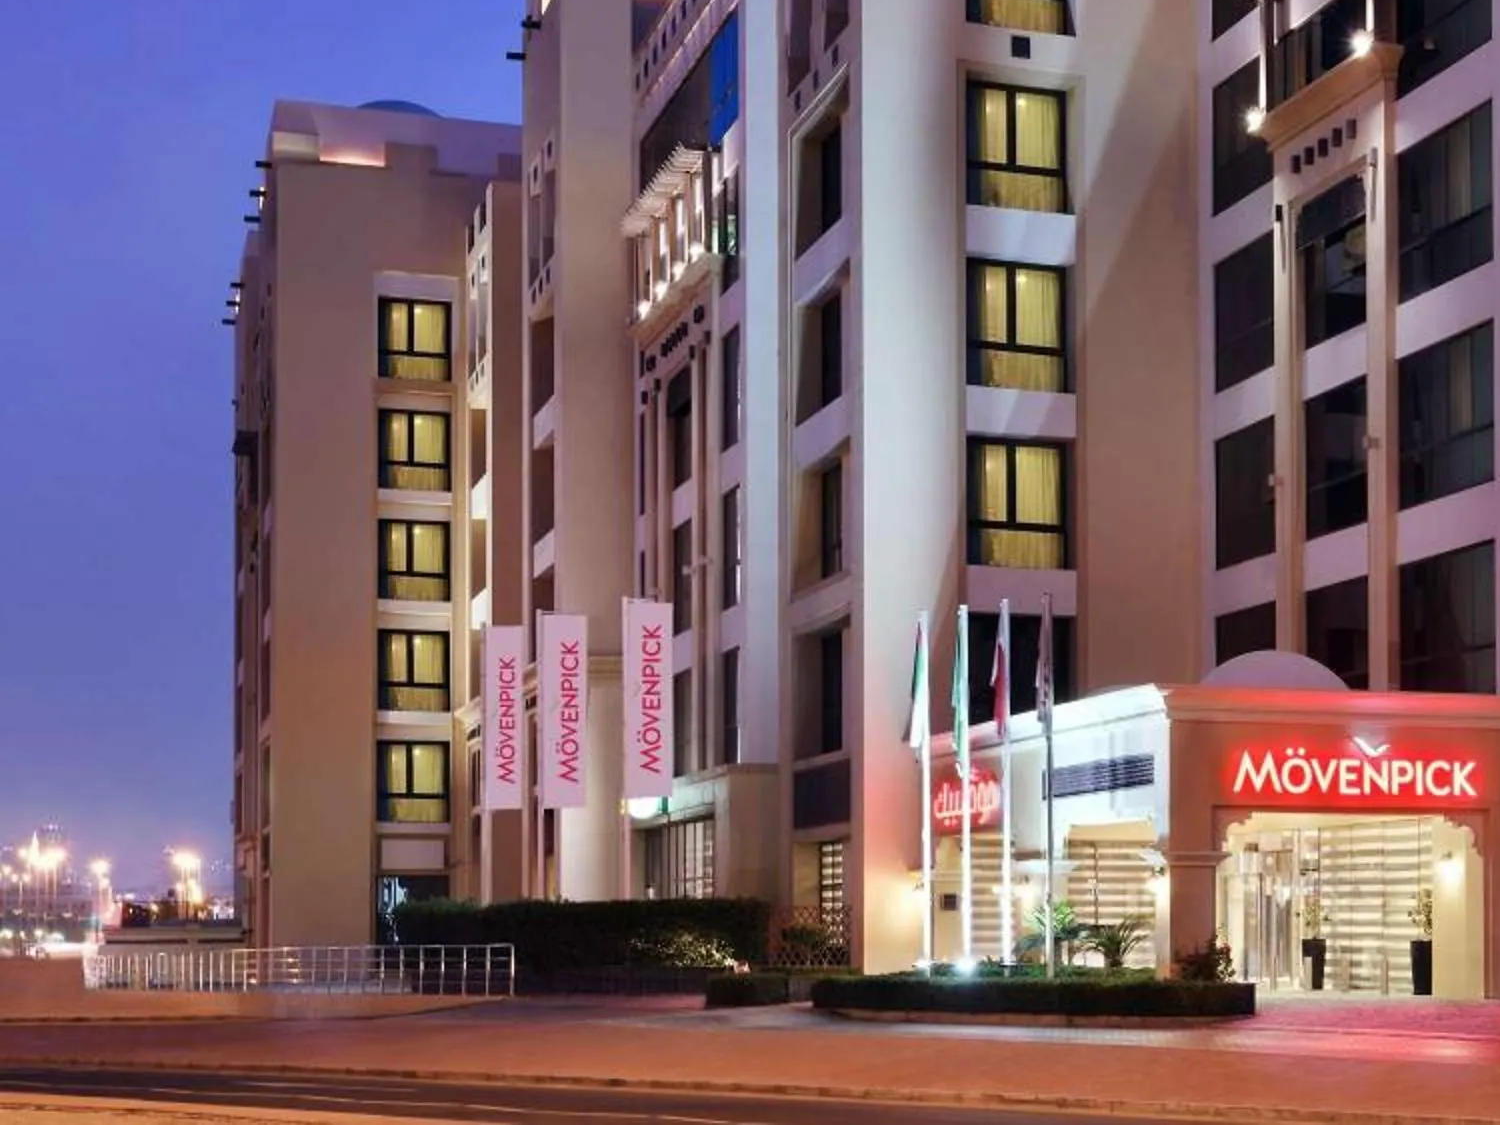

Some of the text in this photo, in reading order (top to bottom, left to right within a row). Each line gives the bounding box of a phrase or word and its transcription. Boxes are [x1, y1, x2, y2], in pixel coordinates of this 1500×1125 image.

[496, 656, 516, 784] MÖVENPICK
[556, 640, 579, 783] MÖVENPICK
[636, 624, 662, 773] MÖVENPICK
[1233, 747, 1477, 796] MÖVENPICK
